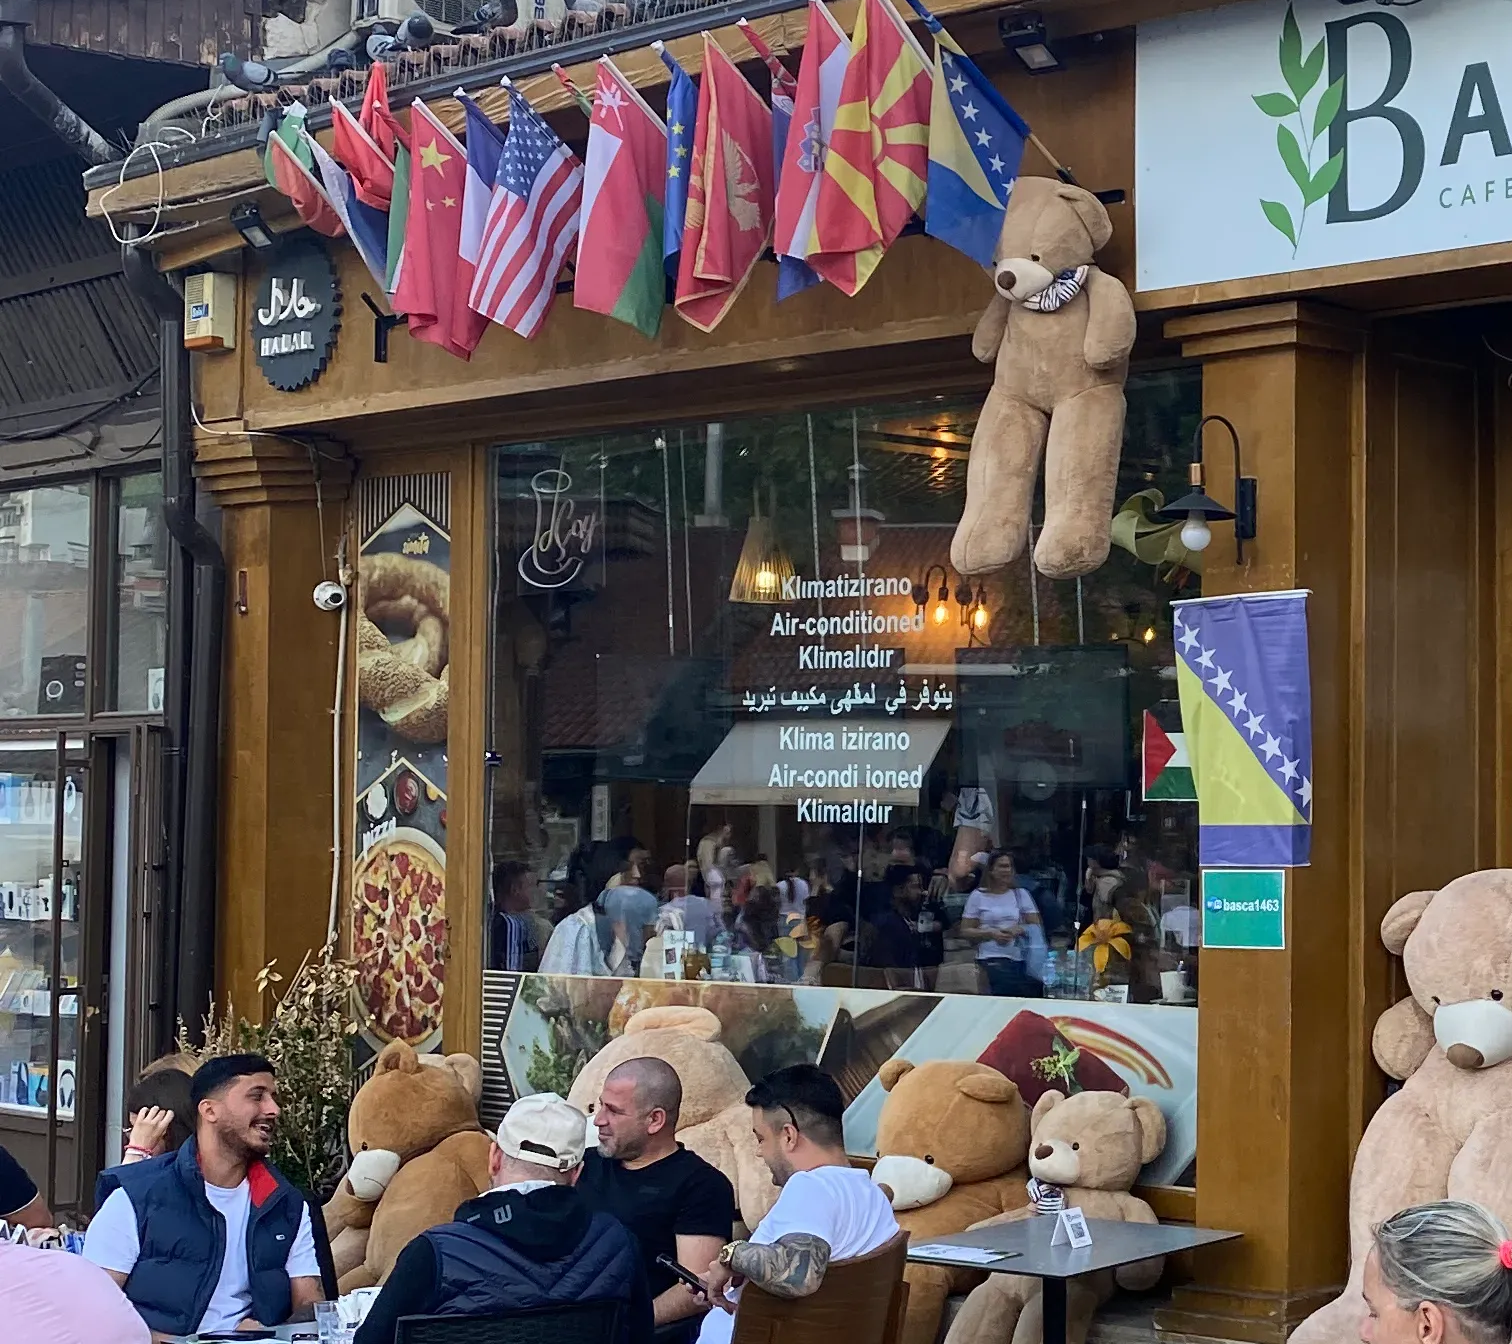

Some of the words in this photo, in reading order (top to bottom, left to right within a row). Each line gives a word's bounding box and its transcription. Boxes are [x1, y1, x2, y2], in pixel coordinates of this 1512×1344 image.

[258, 277, 321, 326] حلال
[260, 330, 315, 357] HALAL
[769, 609, 925, 636] Air-conditioned
[885, 679, 907, 715] في
[1223, 898, 1280, 912] basca1463
